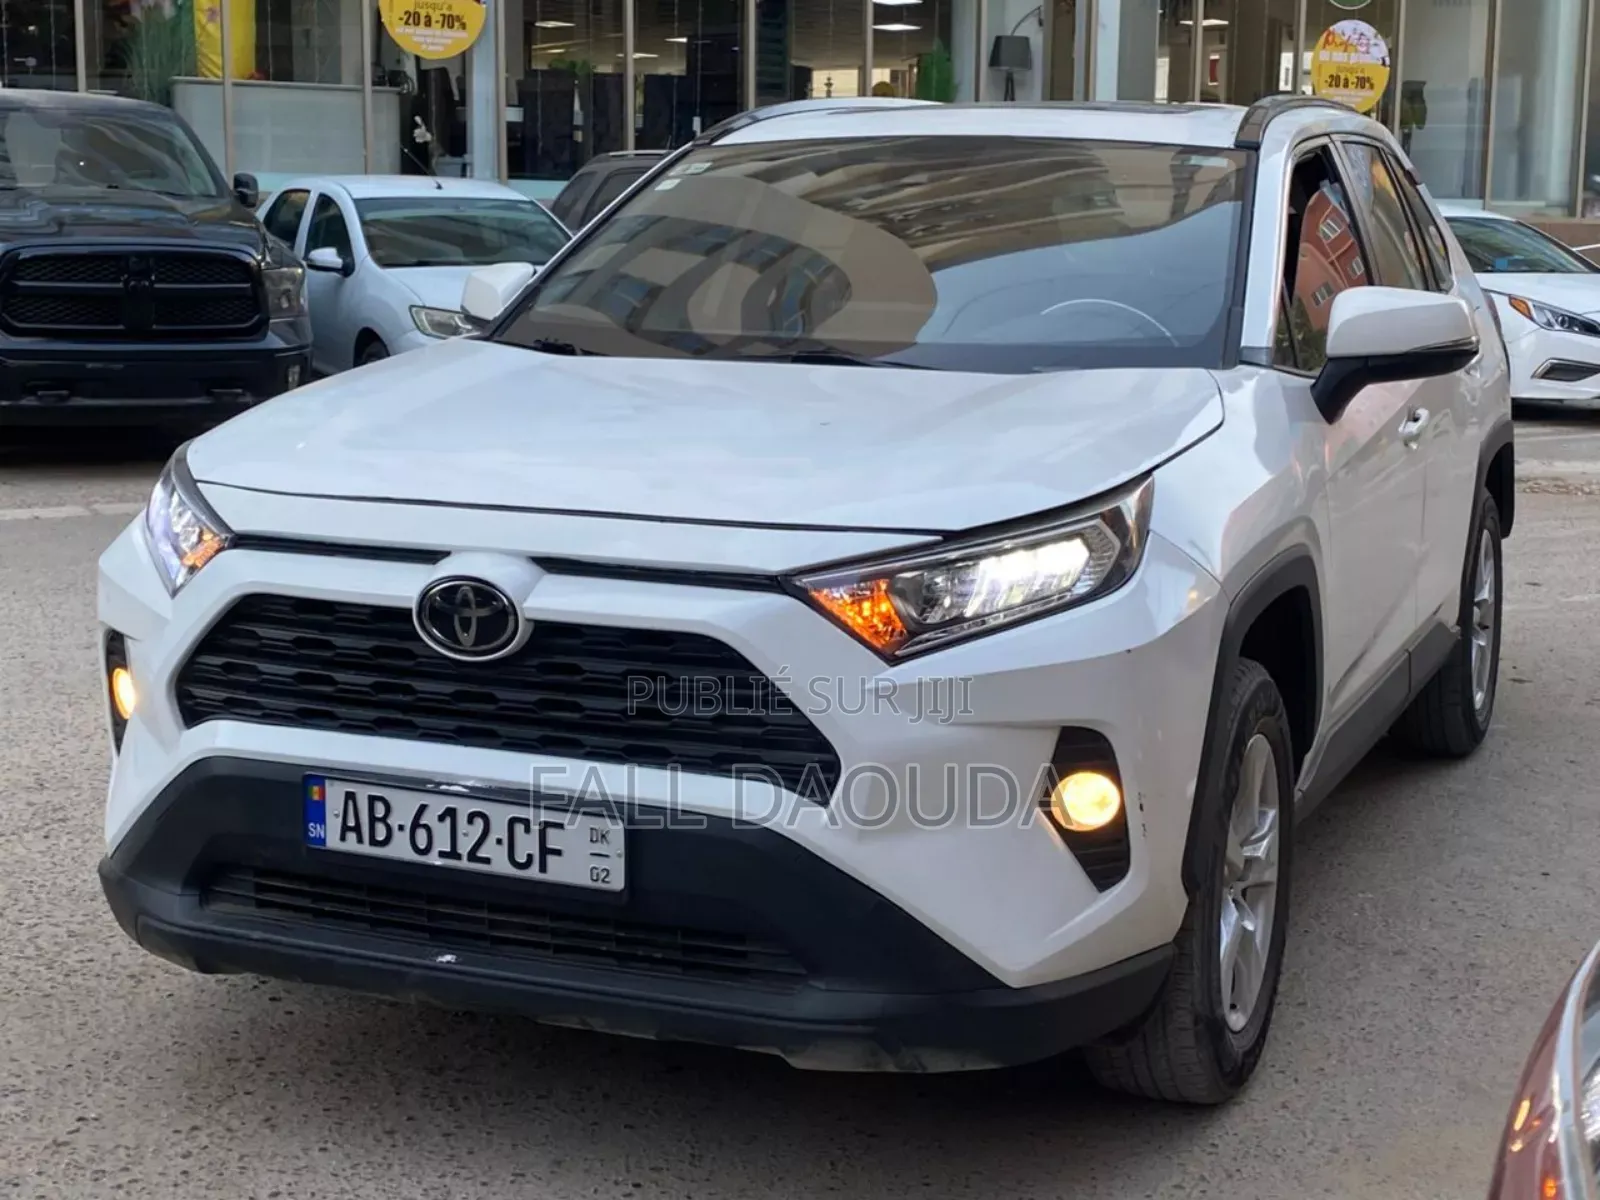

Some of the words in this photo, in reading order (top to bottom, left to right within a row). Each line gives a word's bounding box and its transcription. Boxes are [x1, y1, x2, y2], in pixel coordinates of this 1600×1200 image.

[398, 10, 420, 26] -20
[435, 14, 467, 30] -70%
[1324, 74, 1341, 88] -20
[1351, 76, 1375, 90] -70%
[308, 822, 325, 838] SN
[589, 827, 610, 845] DK
